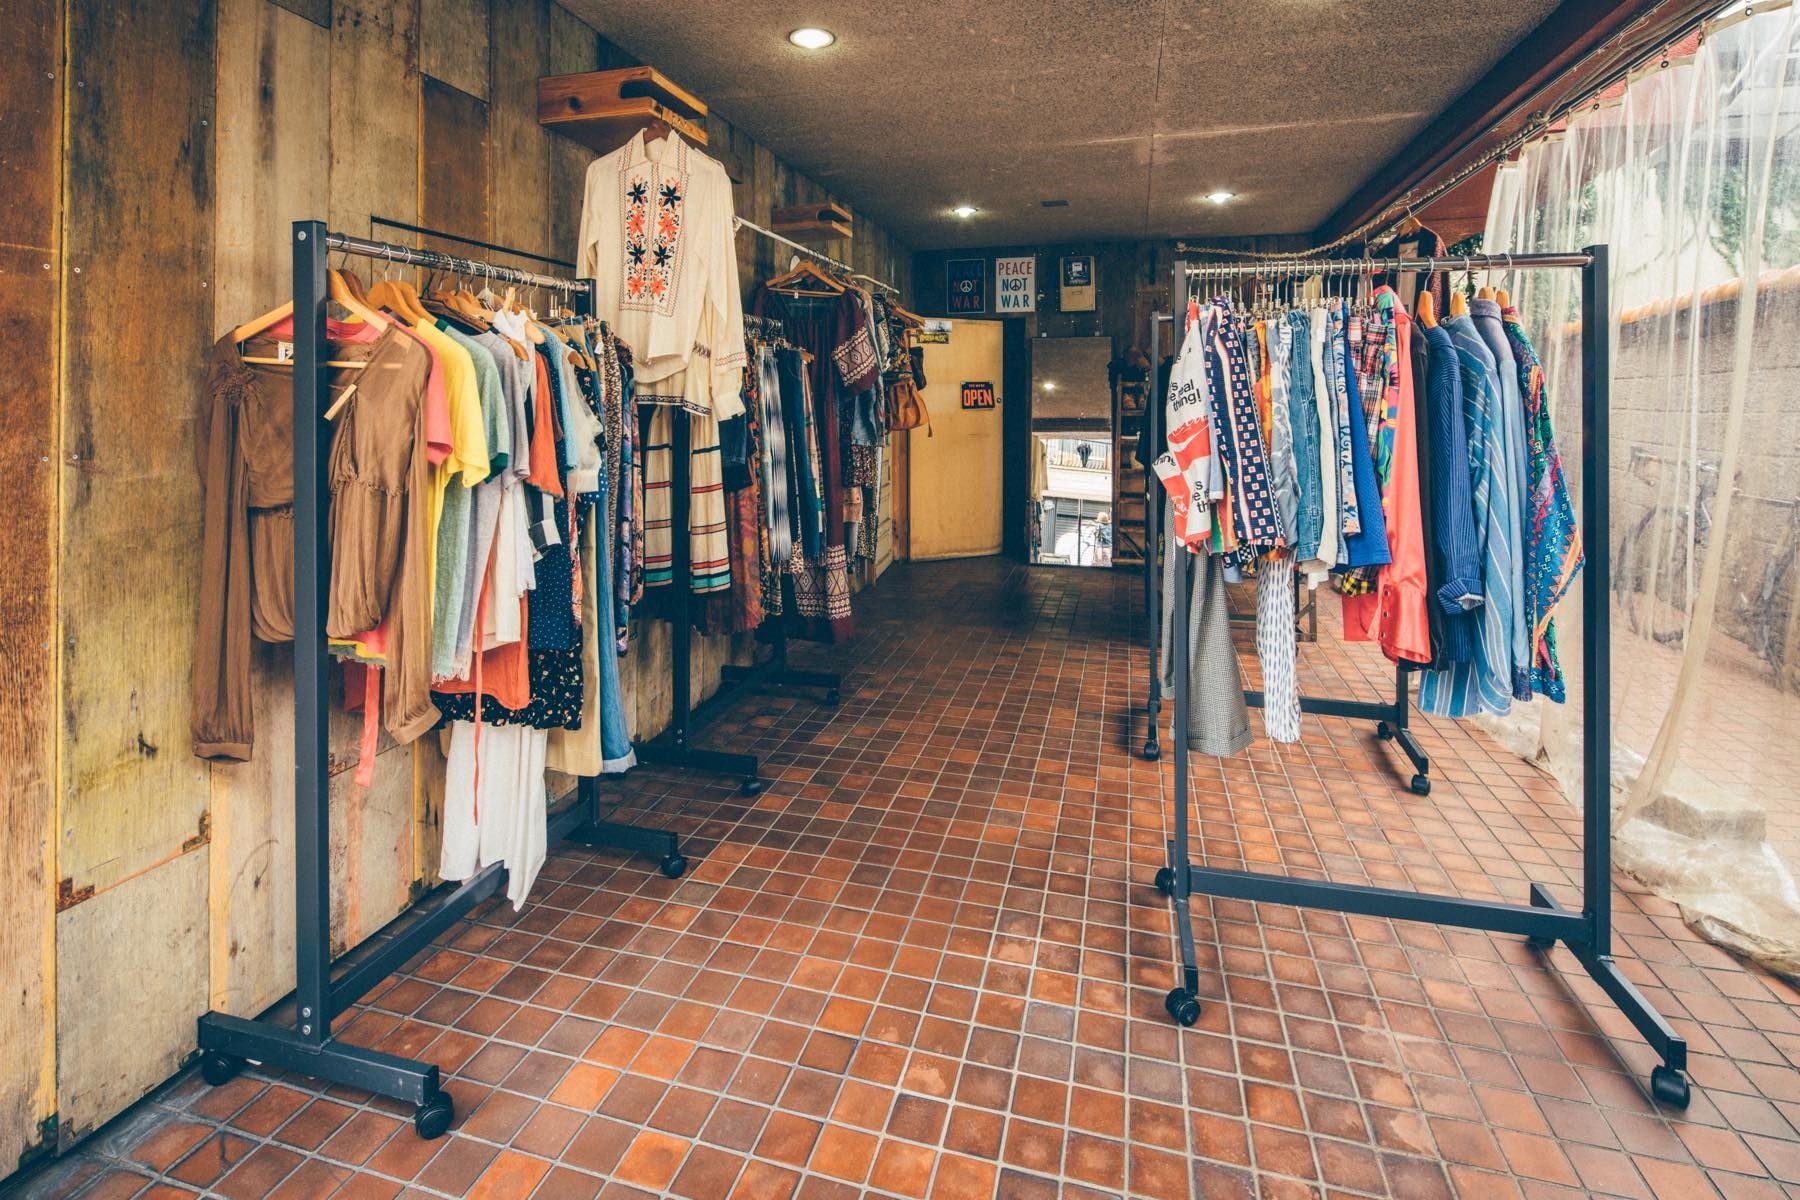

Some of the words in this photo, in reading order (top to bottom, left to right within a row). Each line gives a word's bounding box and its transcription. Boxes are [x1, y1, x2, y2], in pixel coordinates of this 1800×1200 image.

[998, 261, 1032, 275] PEACE
[952, 295, 980, 309] WAR
[1001, 294, 1030, 308] WAR
[963, 389, 993, 407] OPEN
